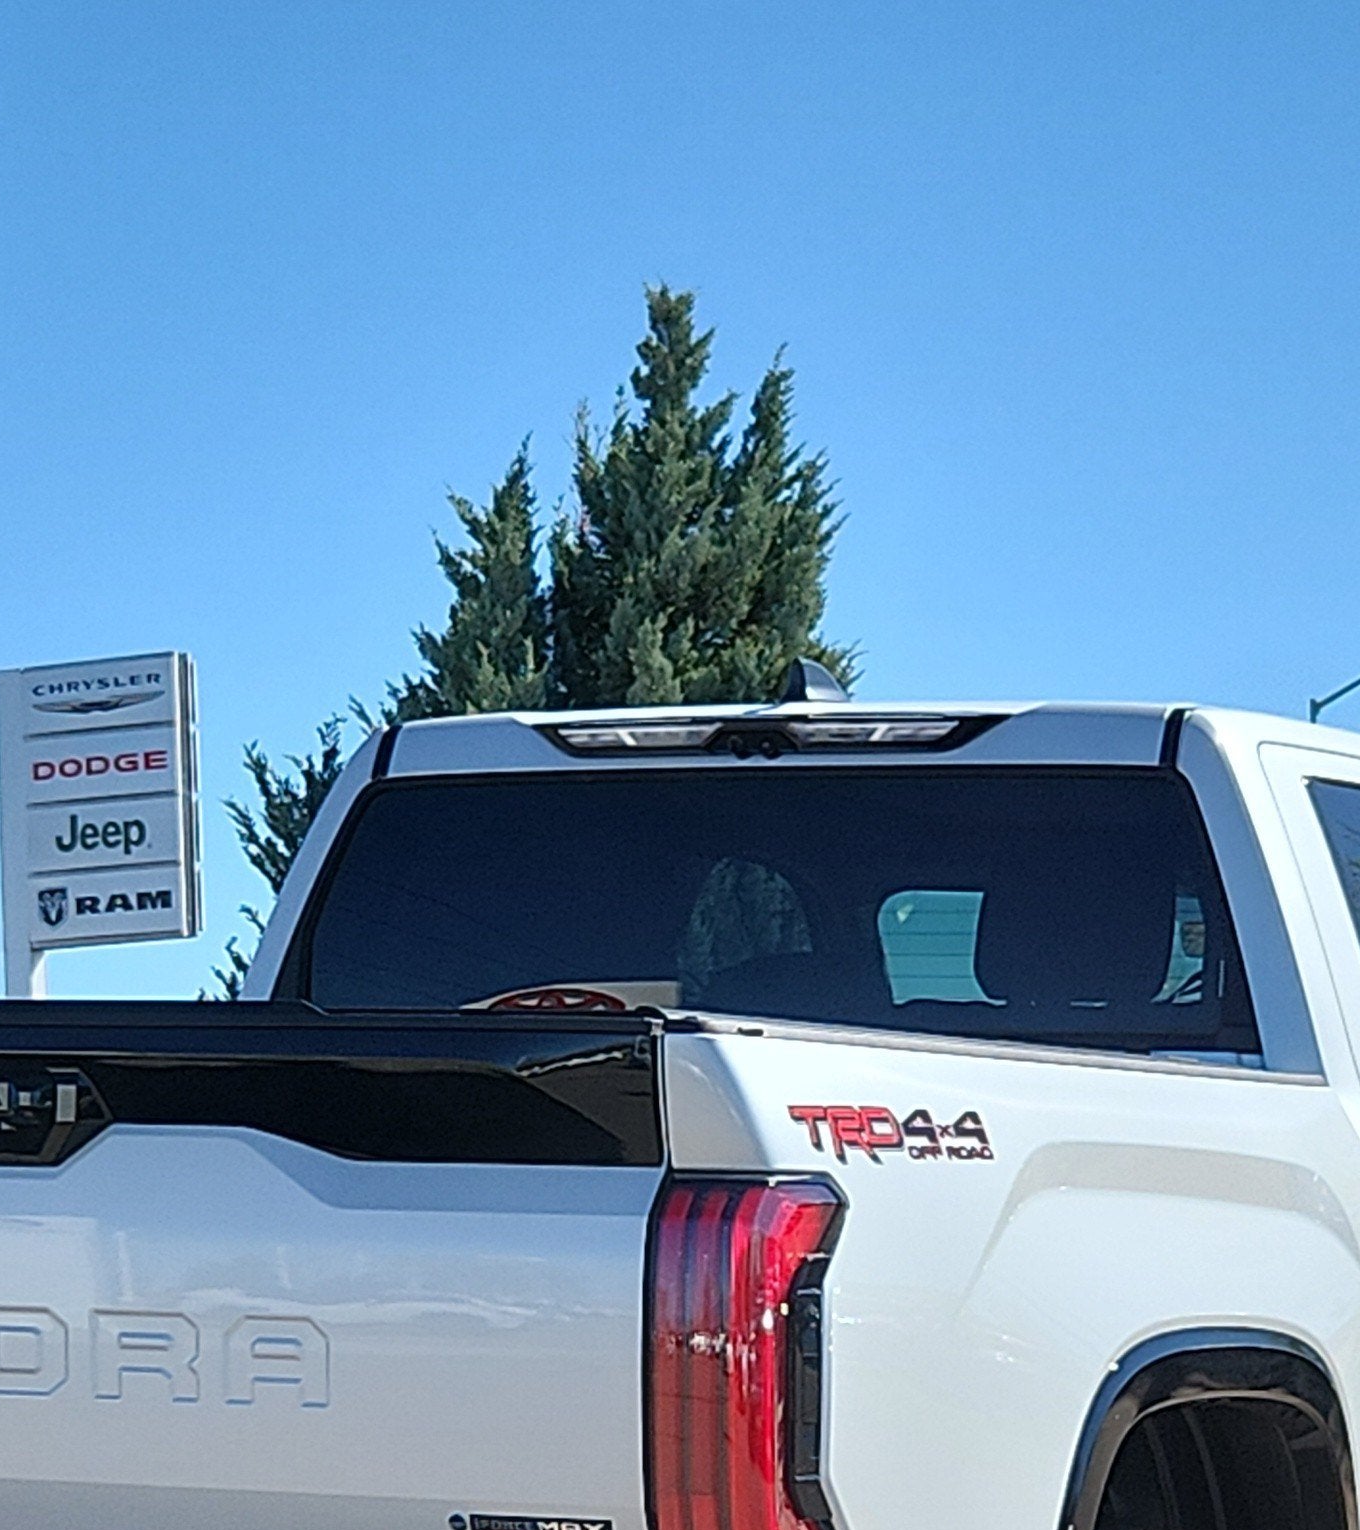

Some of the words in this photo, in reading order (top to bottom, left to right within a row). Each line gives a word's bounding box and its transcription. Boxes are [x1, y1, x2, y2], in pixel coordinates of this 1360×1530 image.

[32, 672, 161, 697] CHRYSLER
[32, 751, 168, 781] DODGE
[55, 814, 147, 854] Jeep
[75, 890, 173, 915] RAM
[787, 1105, 905, 1165] TRD
